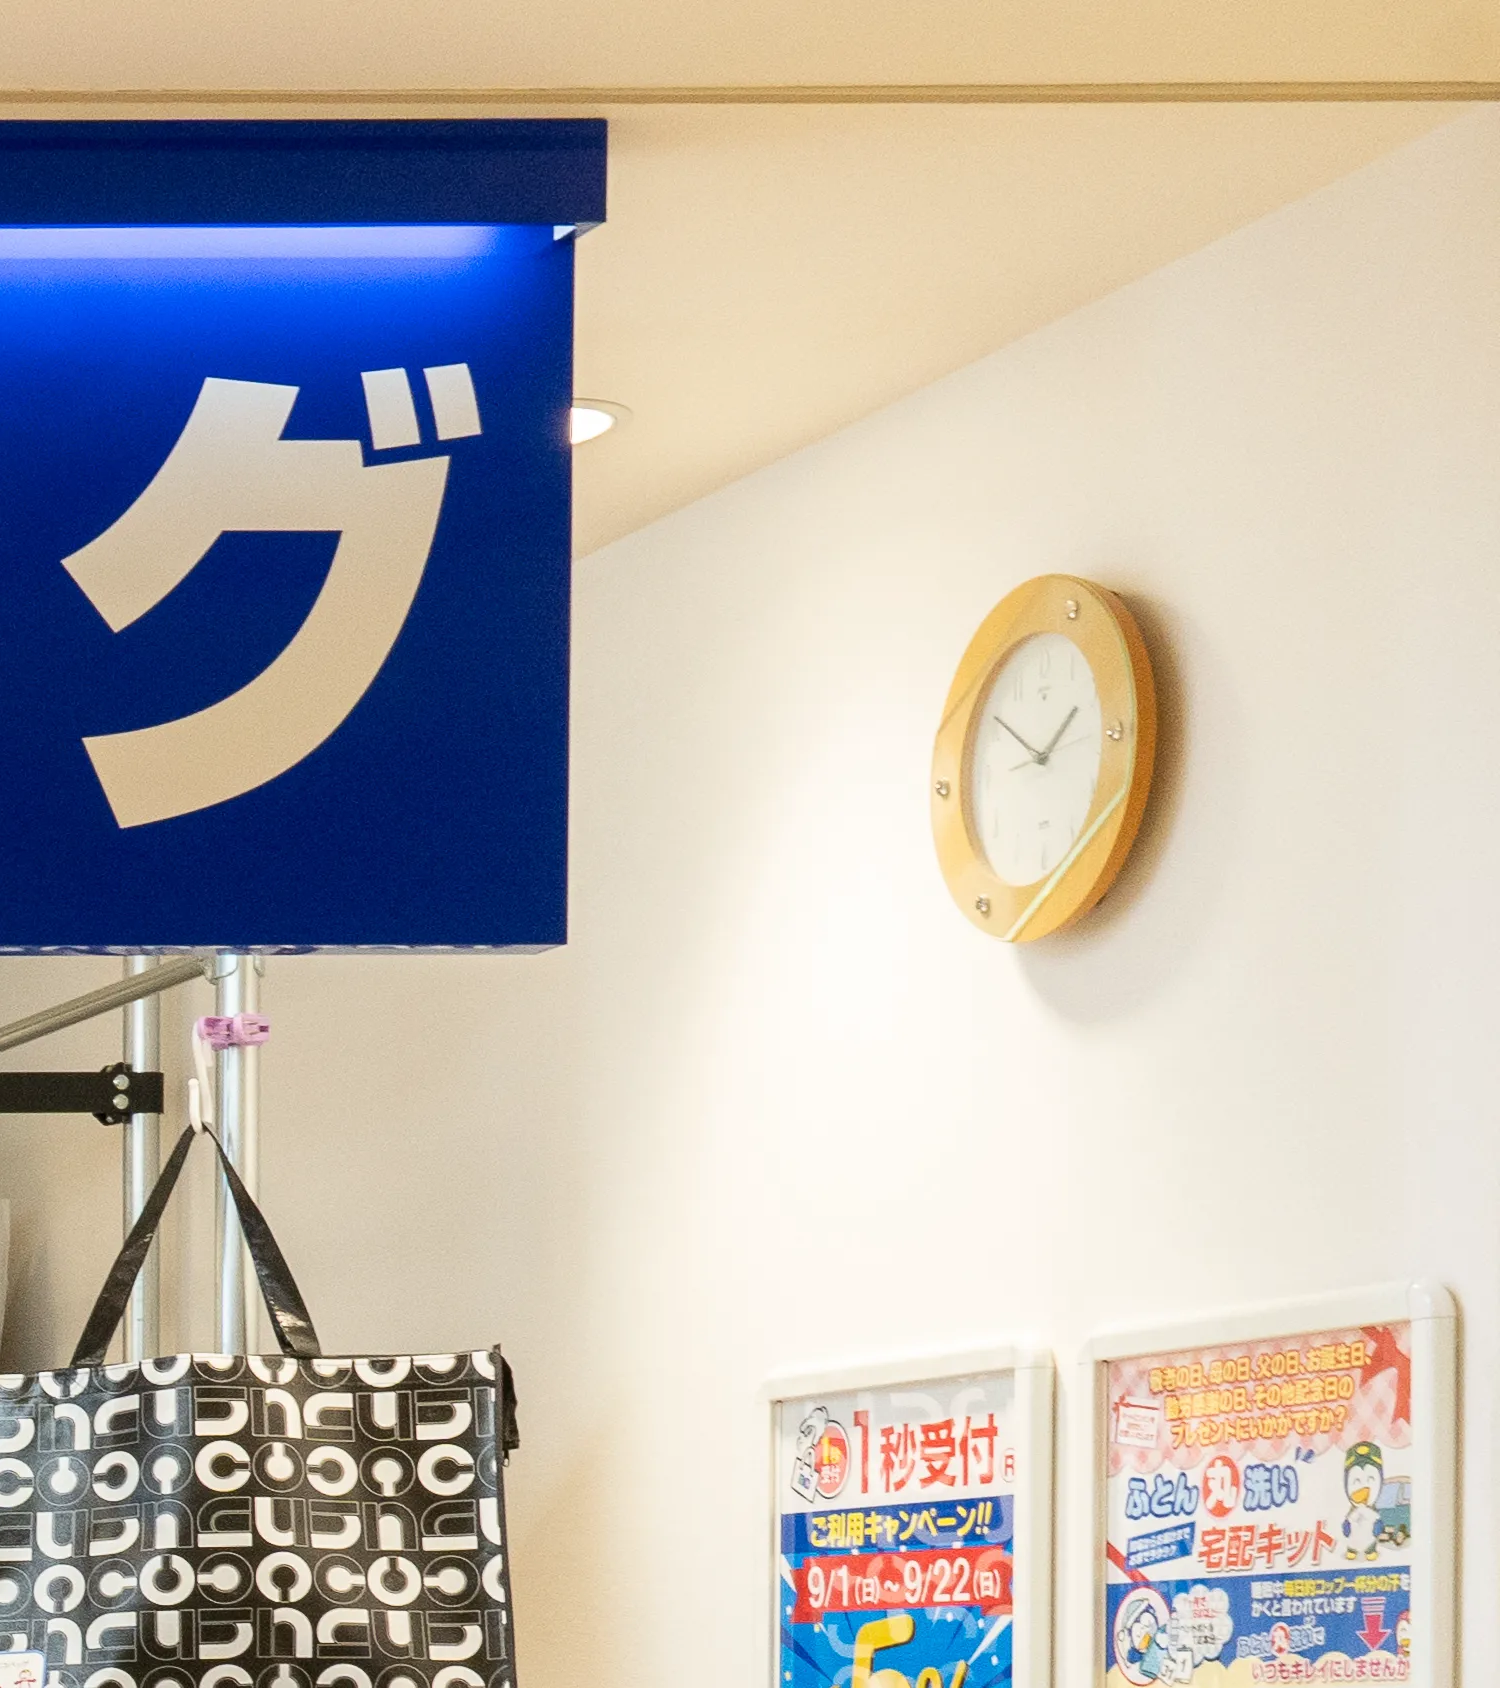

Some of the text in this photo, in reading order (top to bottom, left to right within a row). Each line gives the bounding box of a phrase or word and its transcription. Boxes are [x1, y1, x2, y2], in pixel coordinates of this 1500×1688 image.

[1199, 1520, 1336, 1572] 宅配キット
